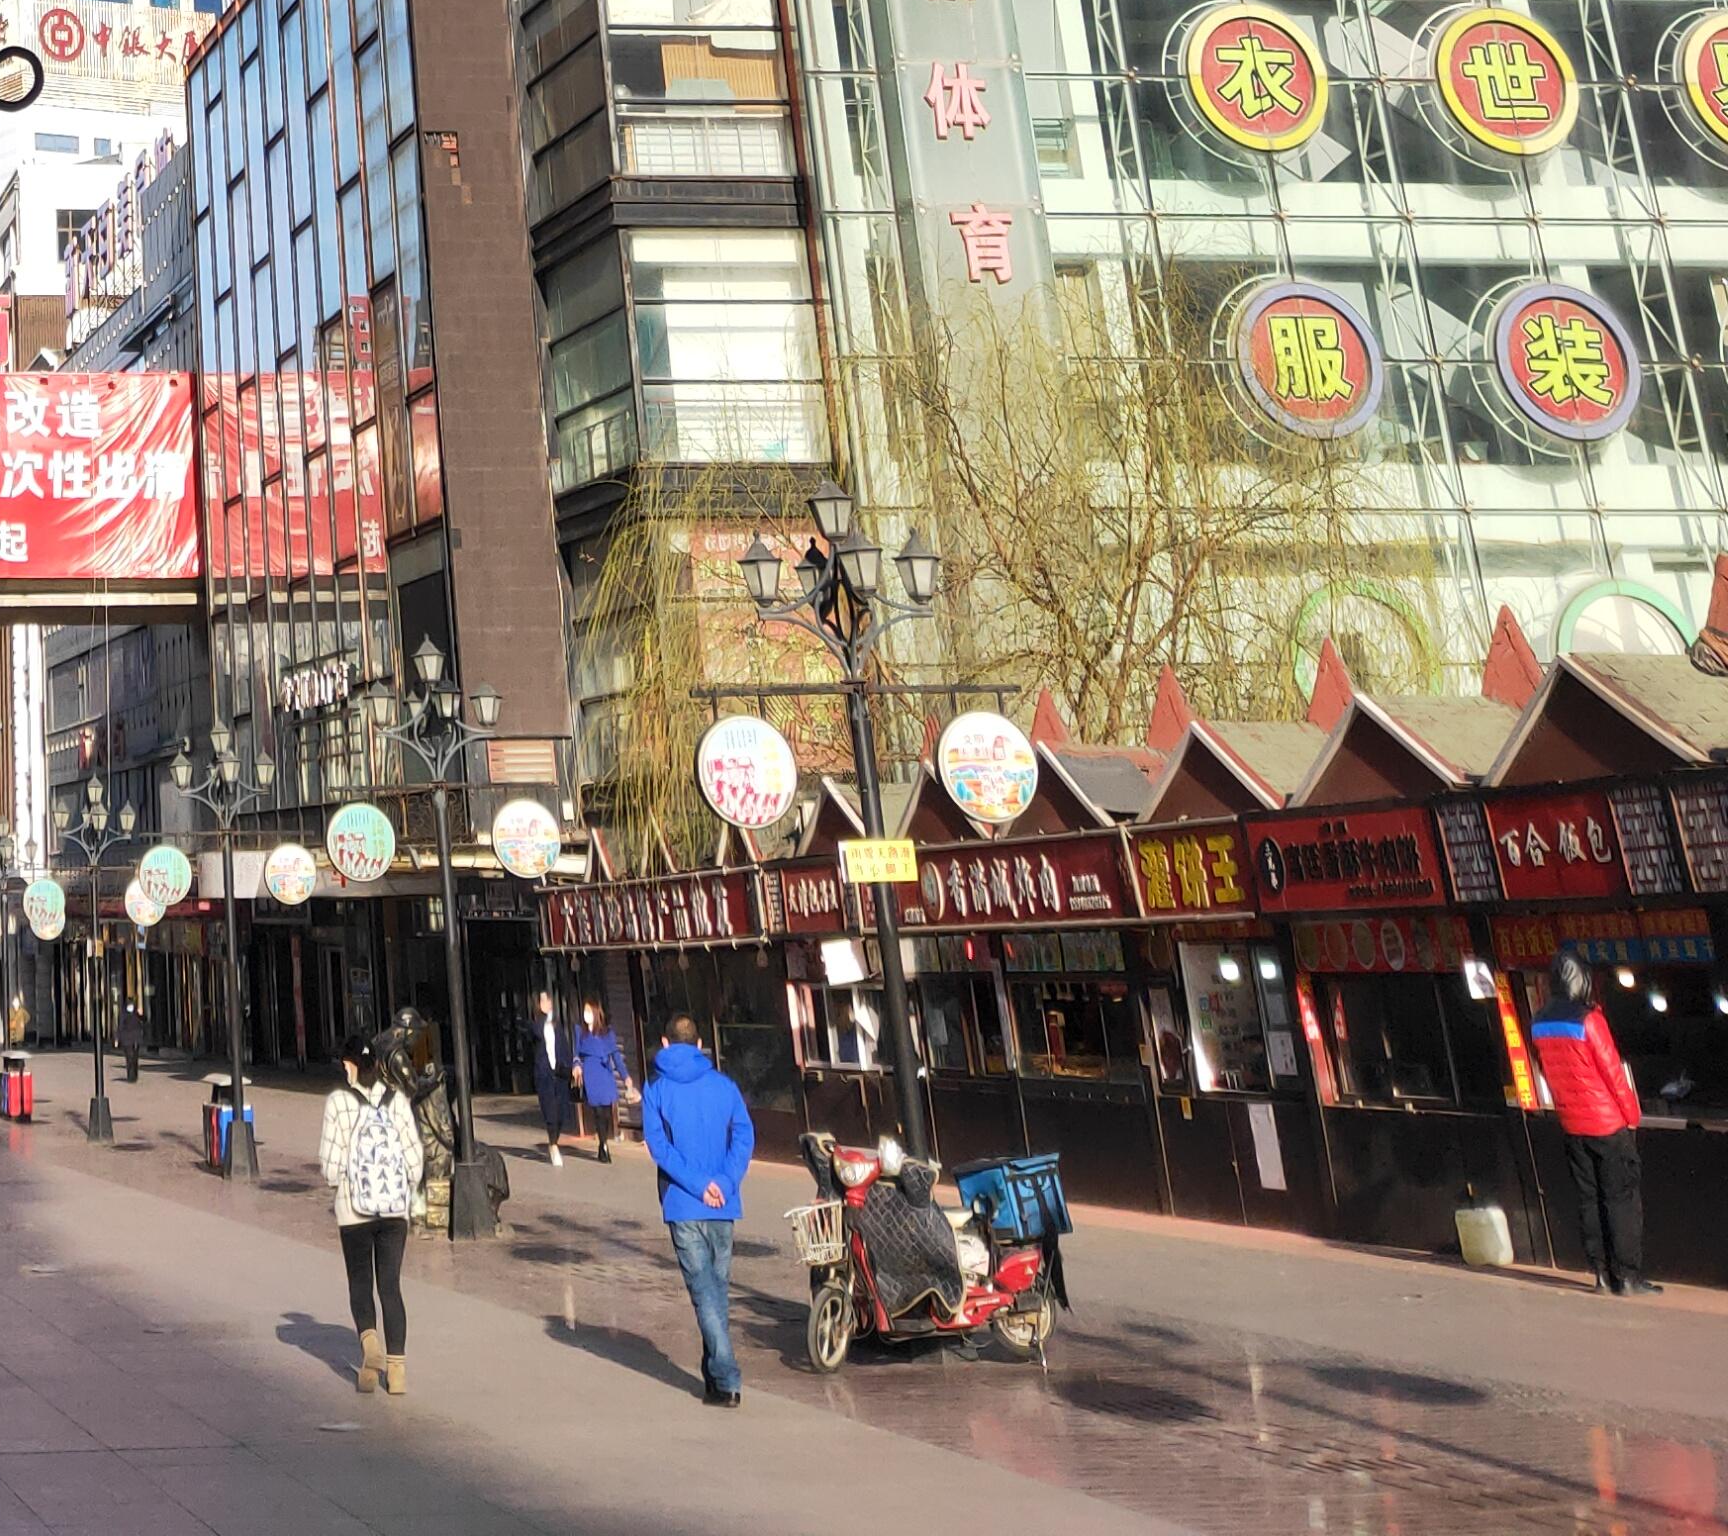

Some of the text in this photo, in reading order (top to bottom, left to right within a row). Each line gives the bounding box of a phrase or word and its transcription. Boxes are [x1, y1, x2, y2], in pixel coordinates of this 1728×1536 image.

[1274, 315, 1615, 408] 服装
[1498, 814, 1614, 868] 百合饭包
